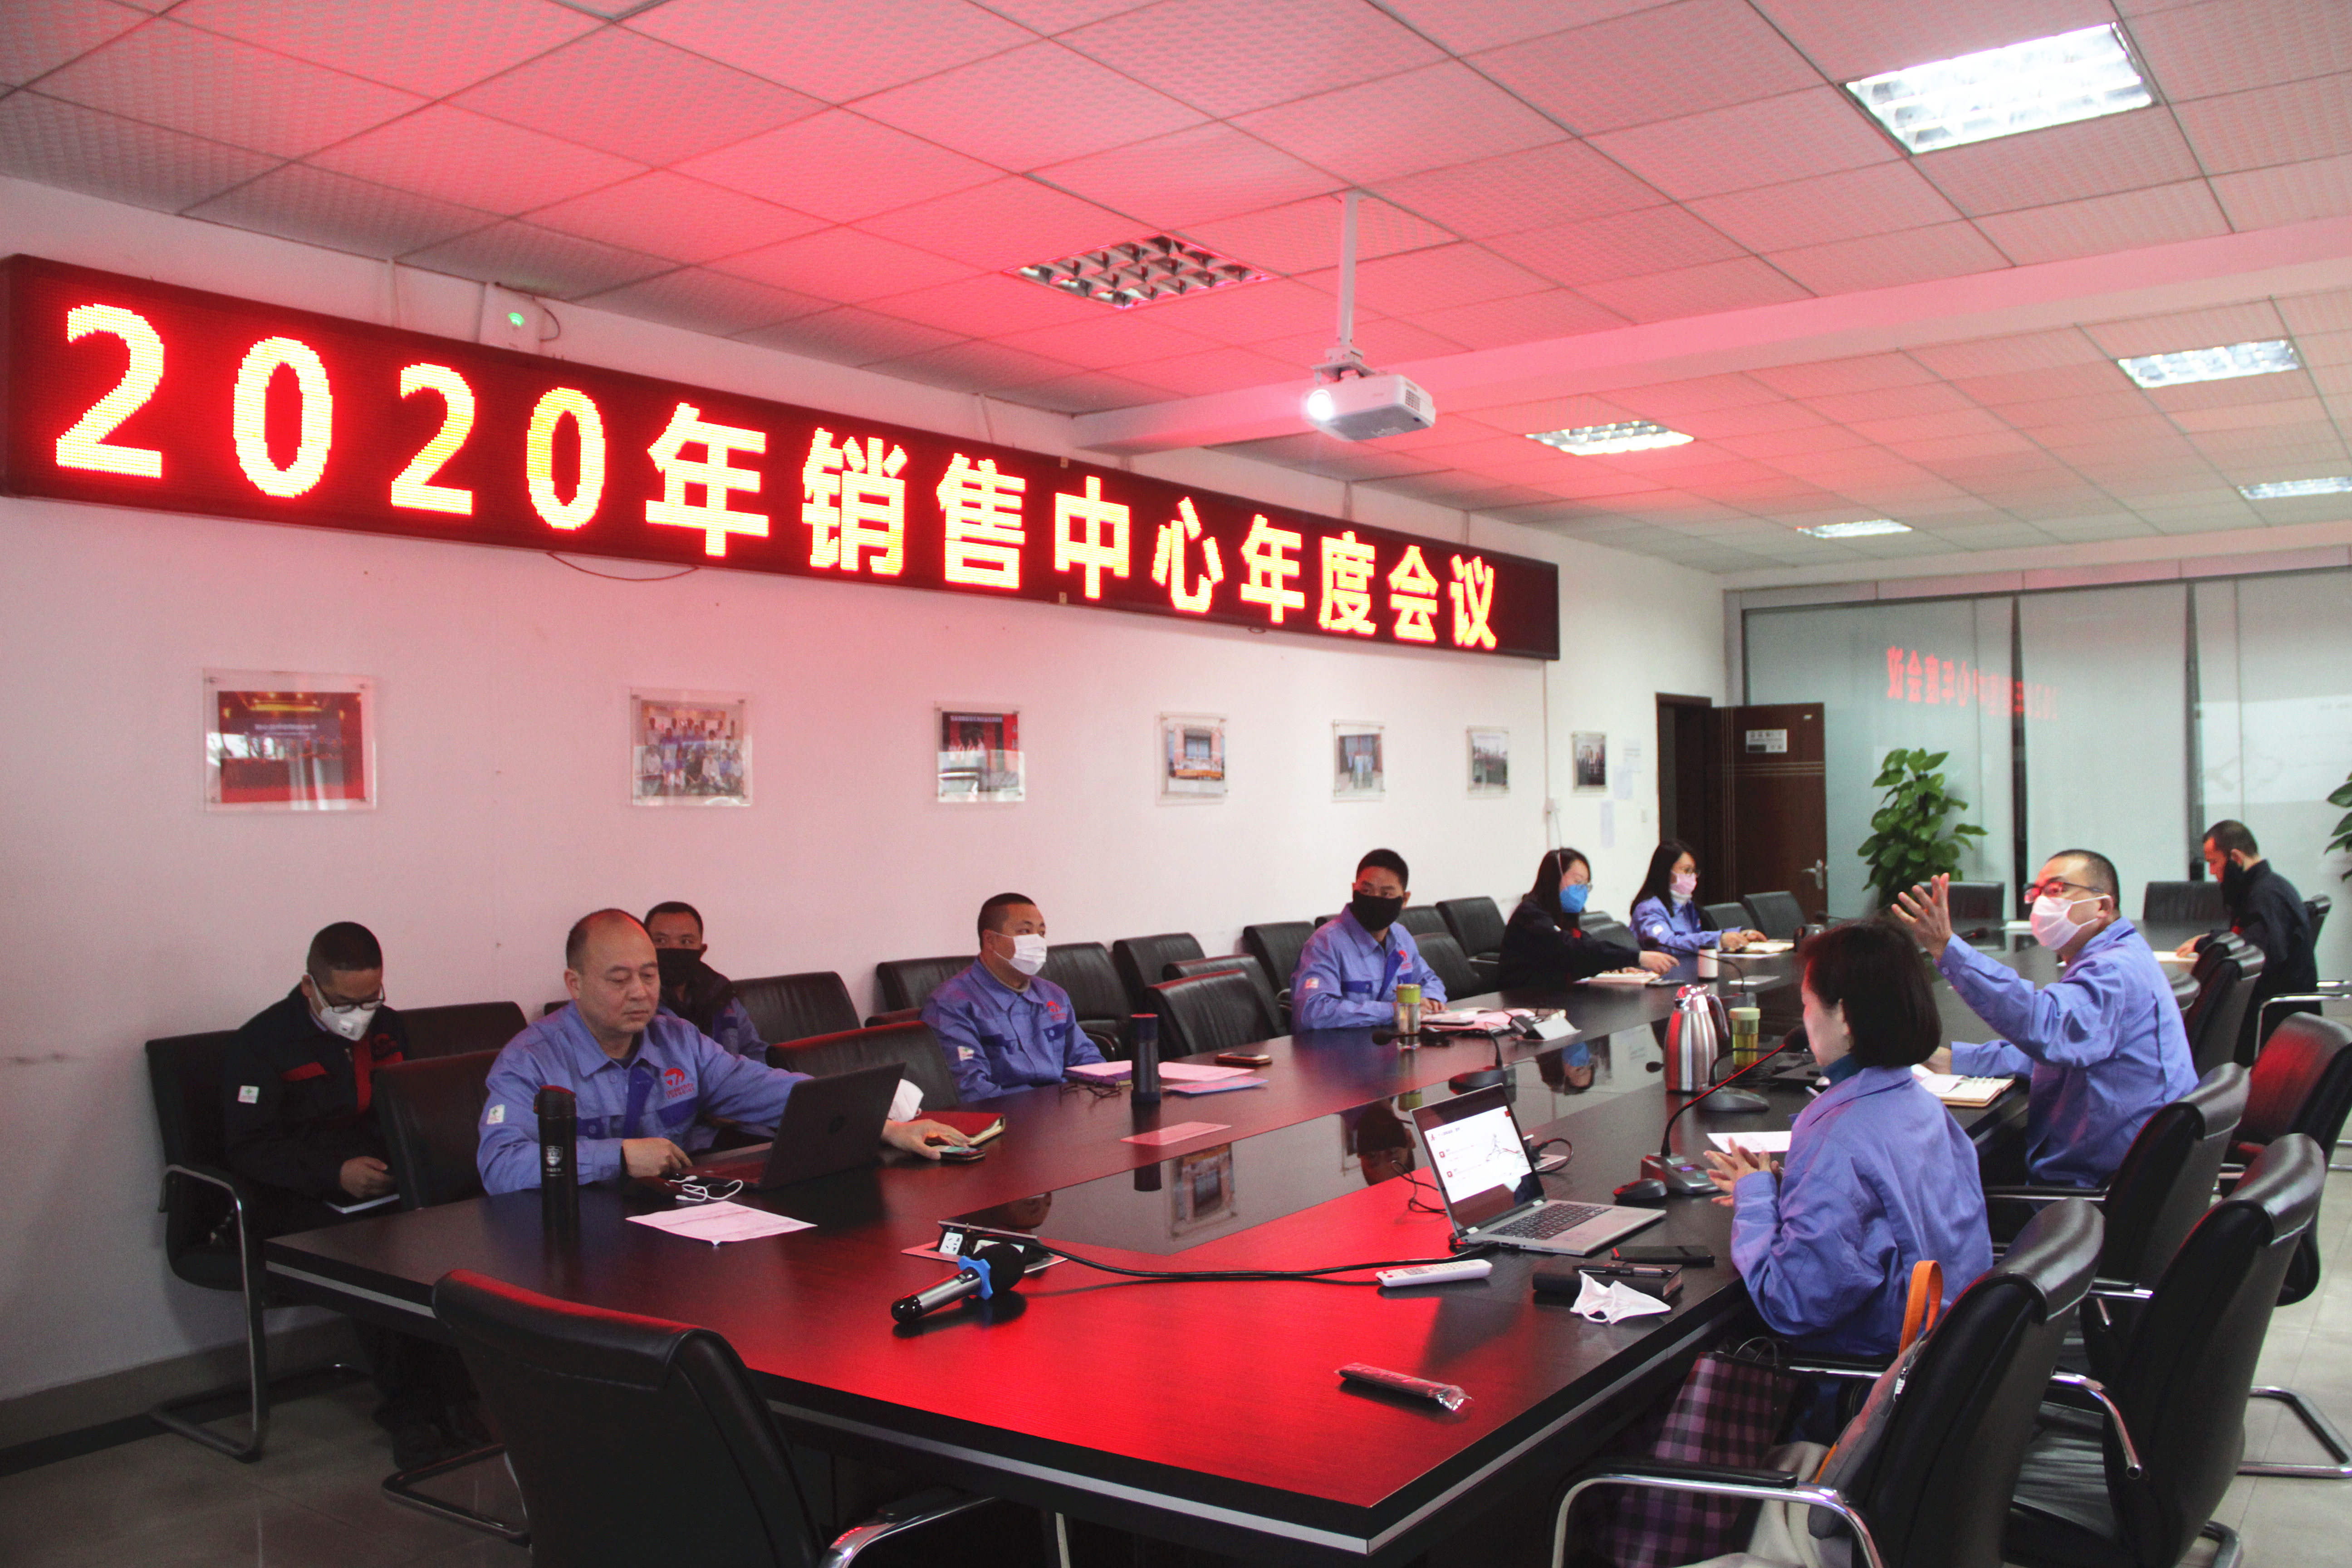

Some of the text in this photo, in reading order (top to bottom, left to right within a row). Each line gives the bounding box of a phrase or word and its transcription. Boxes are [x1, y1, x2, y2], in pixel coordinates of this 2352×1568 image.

[56, 303, 1497, 648] 2020年销售中心年度会议
